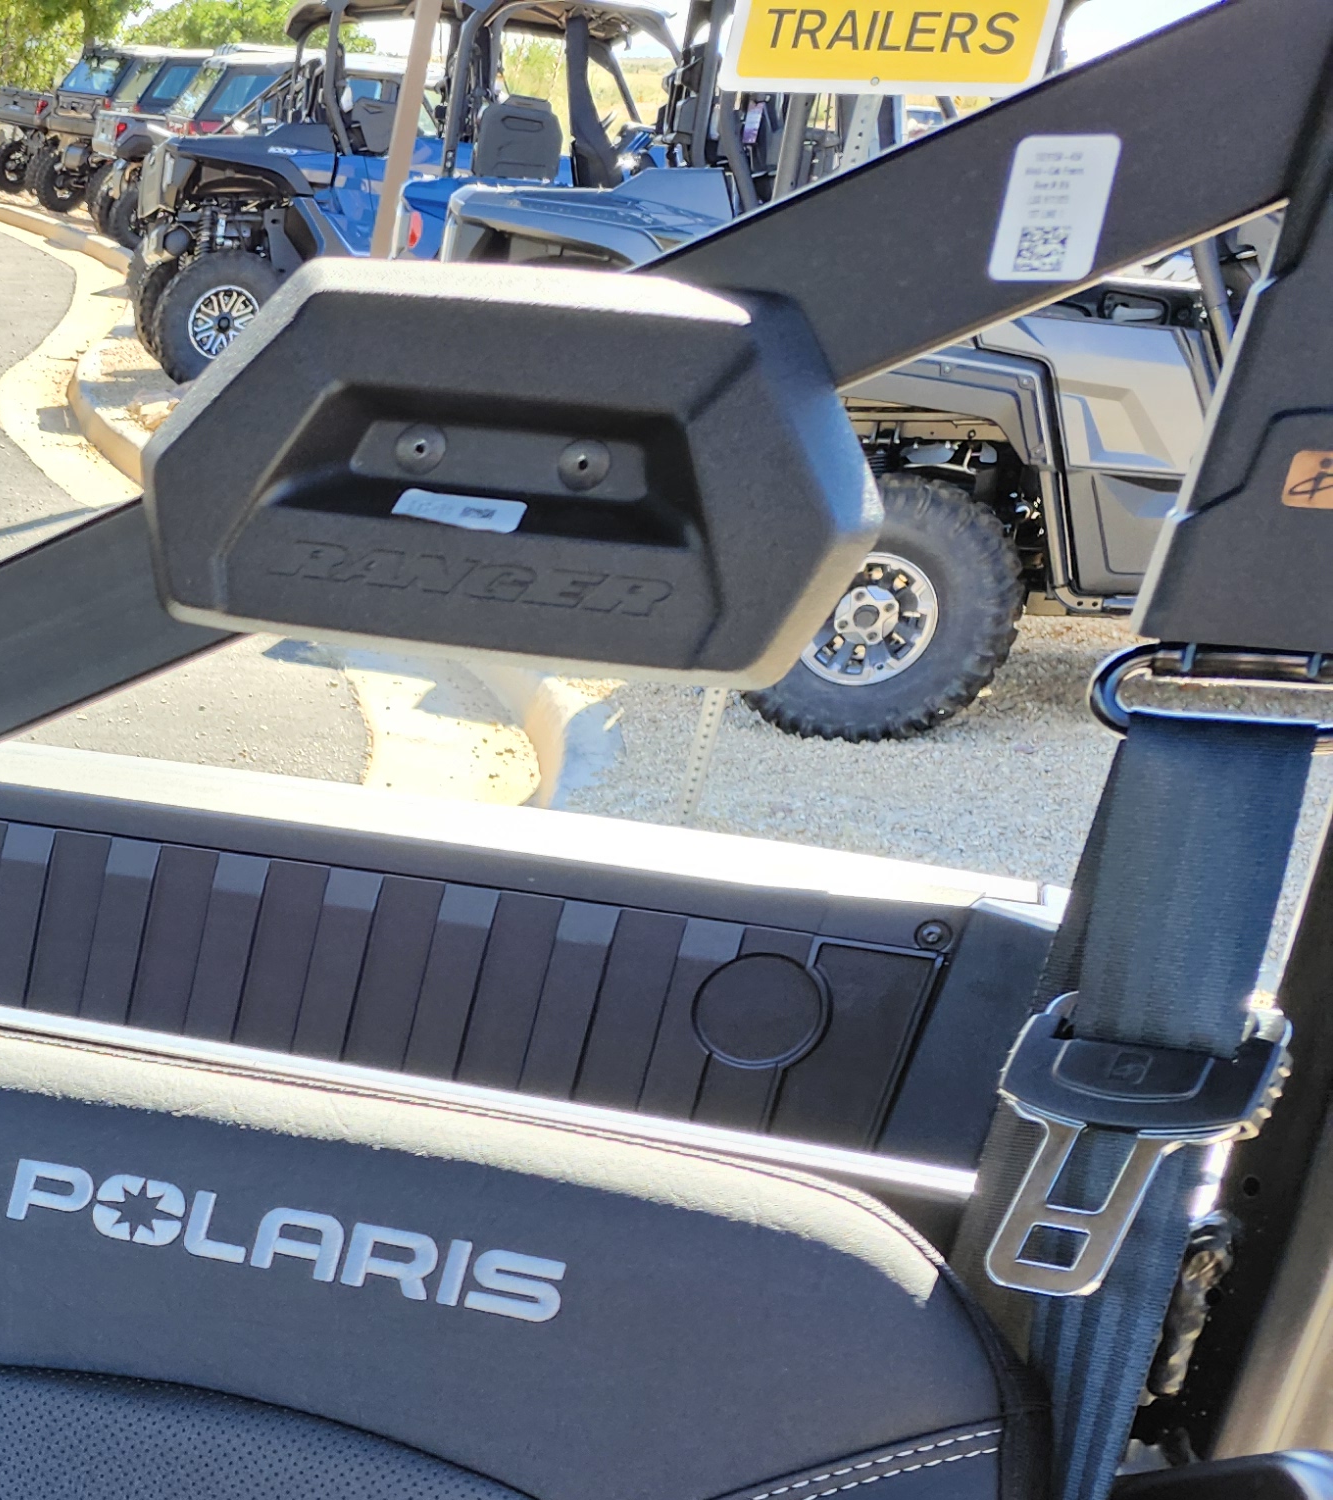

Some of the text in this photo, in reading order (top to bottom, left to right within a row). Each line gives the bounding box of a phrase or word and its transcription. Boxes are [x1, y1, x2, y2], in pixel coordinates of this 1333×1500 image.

[767, 8, 1021, 56] TRAILERS
[265, 538, 675, 618] RANGER
[5, 1157, 567, 1323] POLARIS
